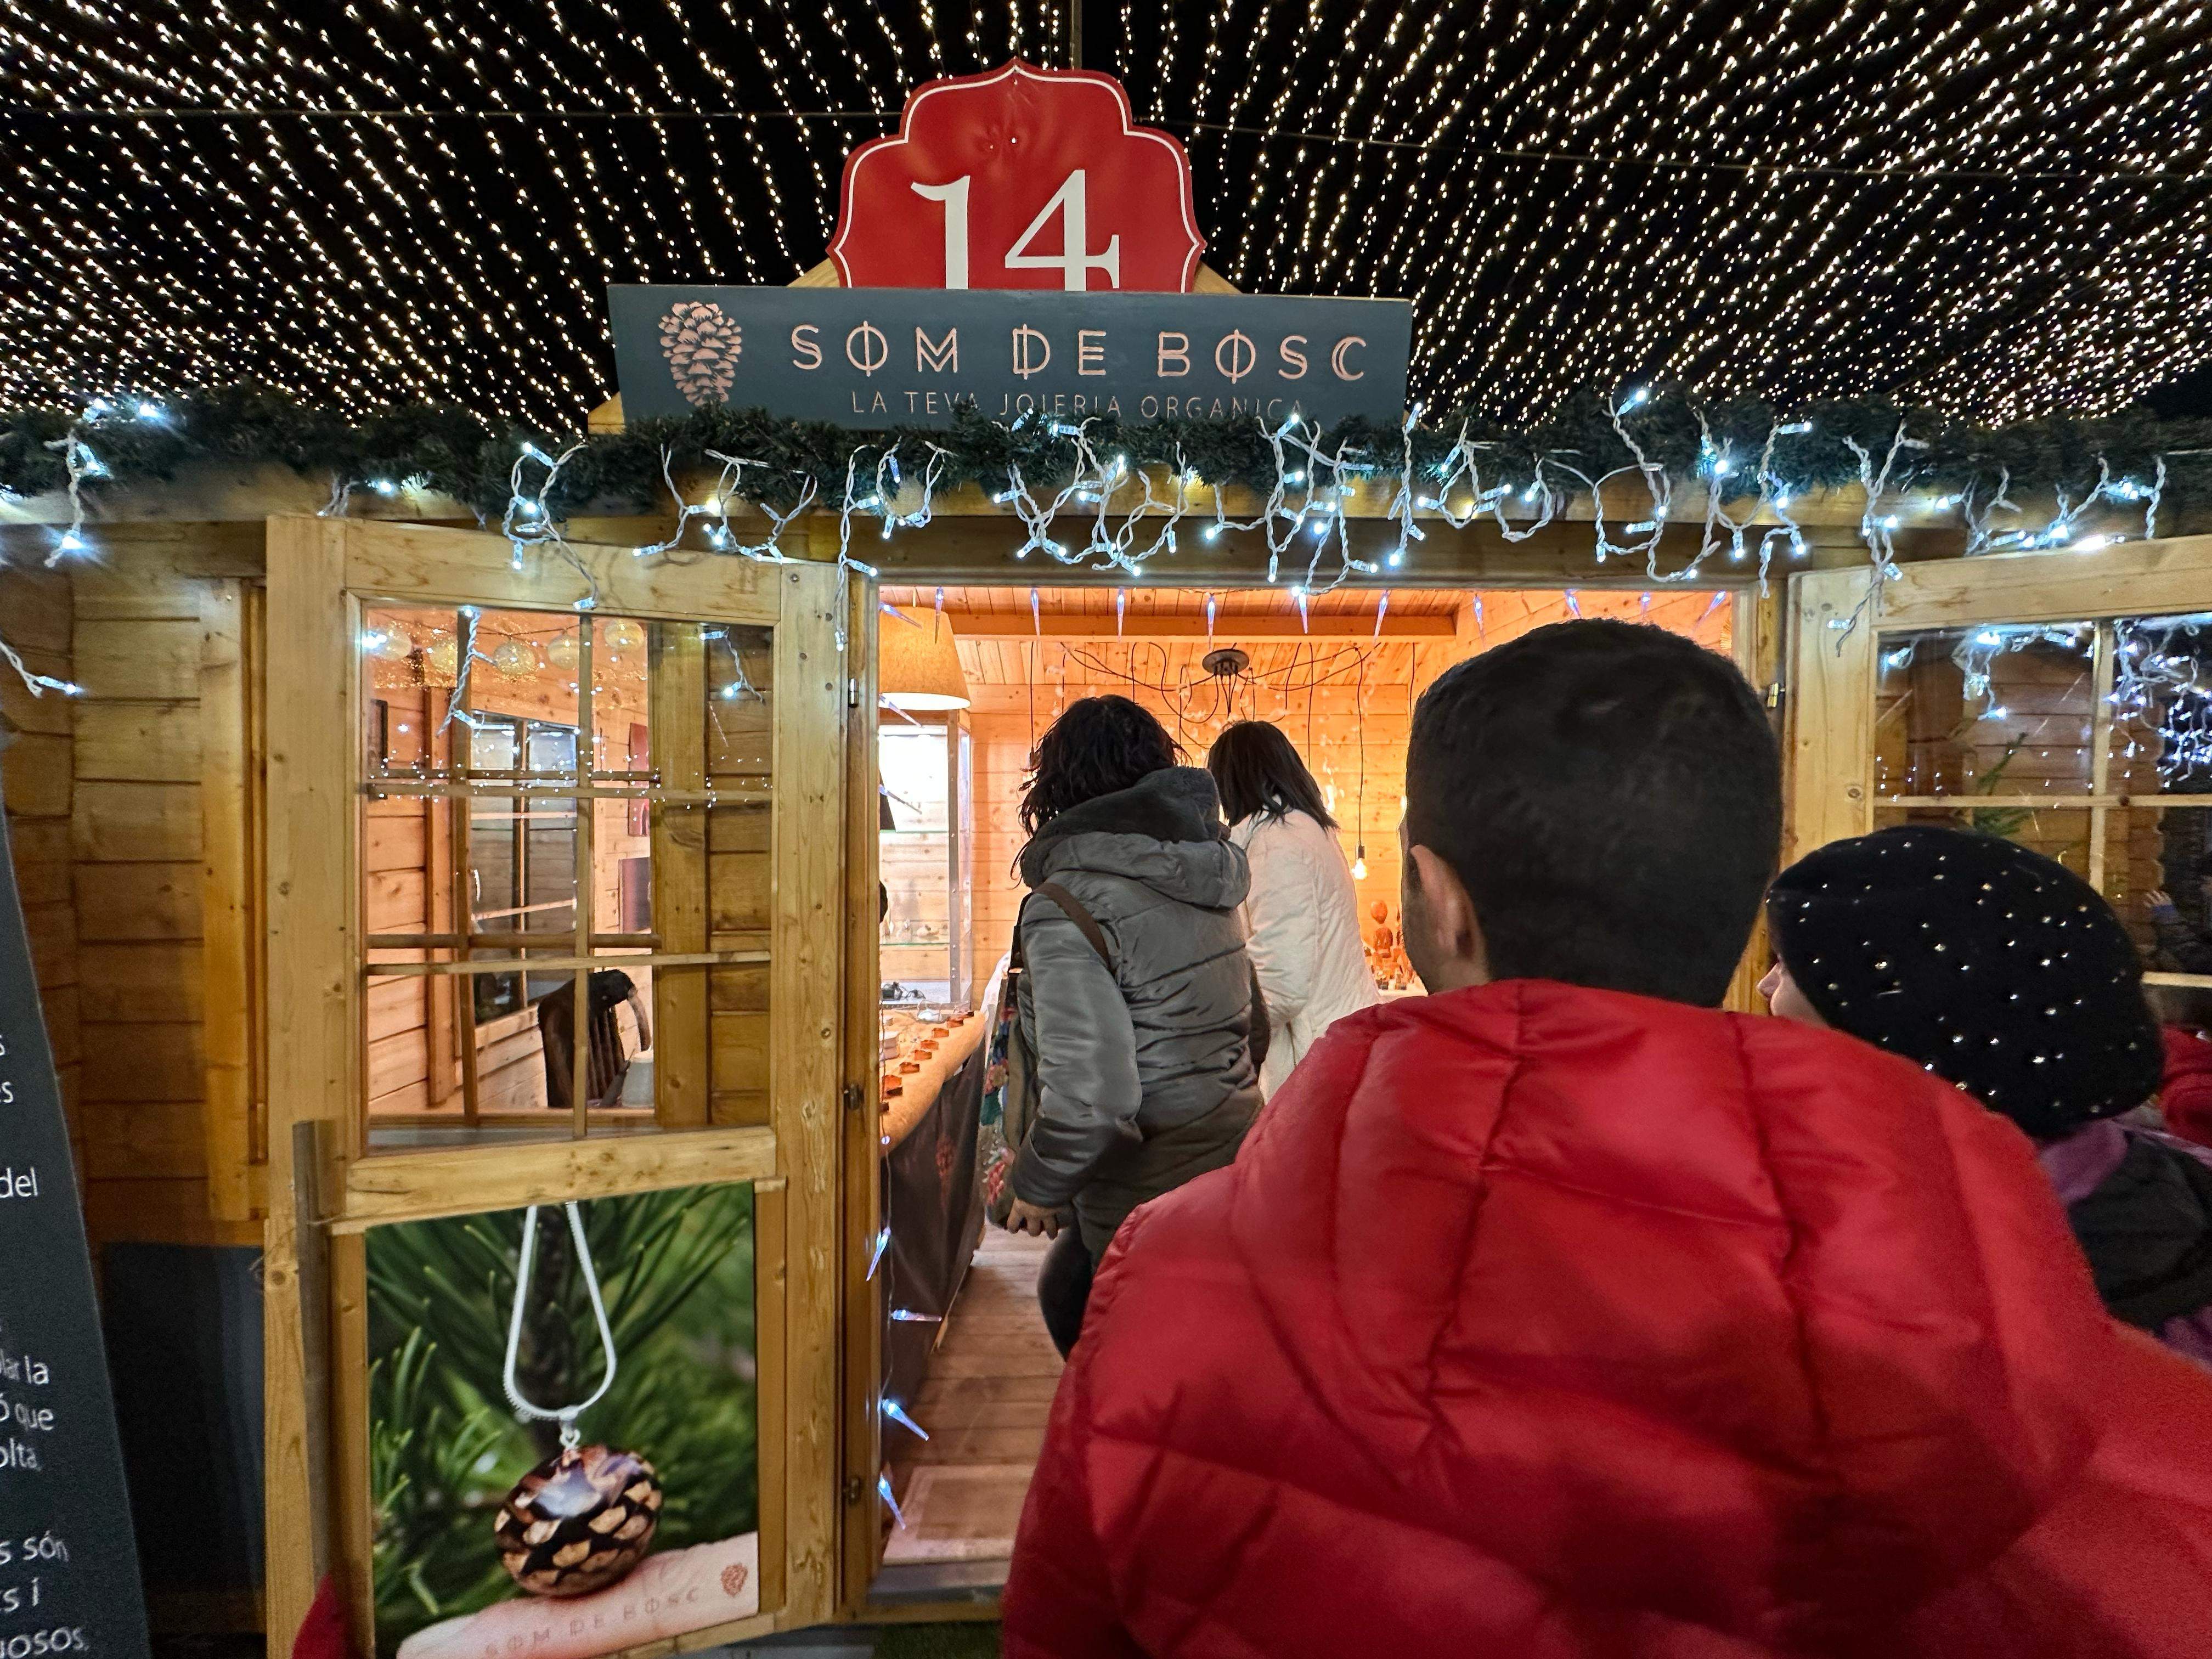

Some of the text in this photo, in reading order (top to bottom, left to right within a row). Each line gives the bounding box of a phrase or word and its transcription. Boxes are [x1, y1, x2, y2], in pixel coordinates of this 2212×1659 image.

[911, 170, 1119, 291] 14
[1012, 324, 1107, 380] DE
[852, 391, 887, 413] LA
[25, 1355, 49, 1385] la
[15, 1403, 54, 1431] que
